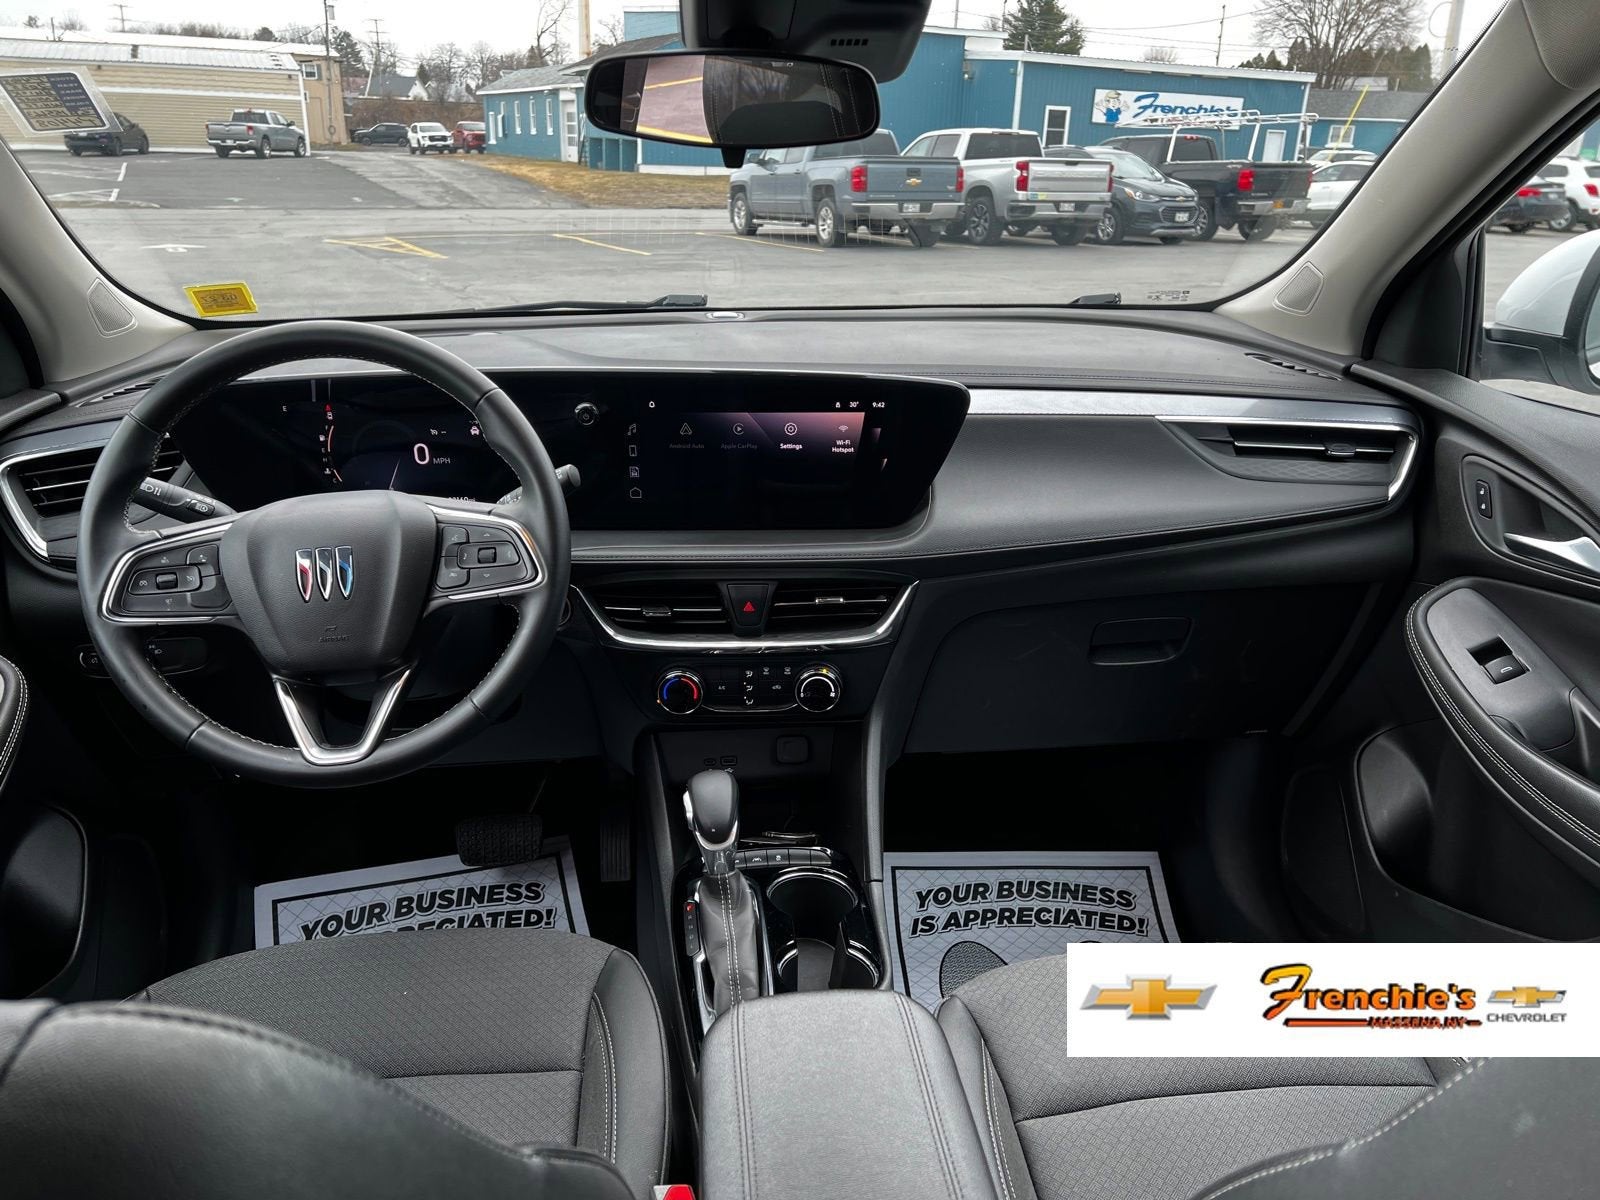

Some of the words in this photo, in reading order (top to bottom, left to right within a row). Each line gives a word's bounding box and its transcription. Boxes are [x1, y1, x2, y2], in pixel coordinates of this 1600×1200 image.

[1132, 92, 1240, 119] Frenchie's
[413, 442, 430, 465] 0
[780, 442, 803, 450] Settings
[915, 881, 992, 910] YOUR
[996, 879, 1136, 909] BUSINESS
[300, 901, 388, 941] YOUR
[393, 881, 546, 917] BUSINESS
[910, 914, 937, 937] IS
[941, 906, 1148, 935] APPRECIATED!
